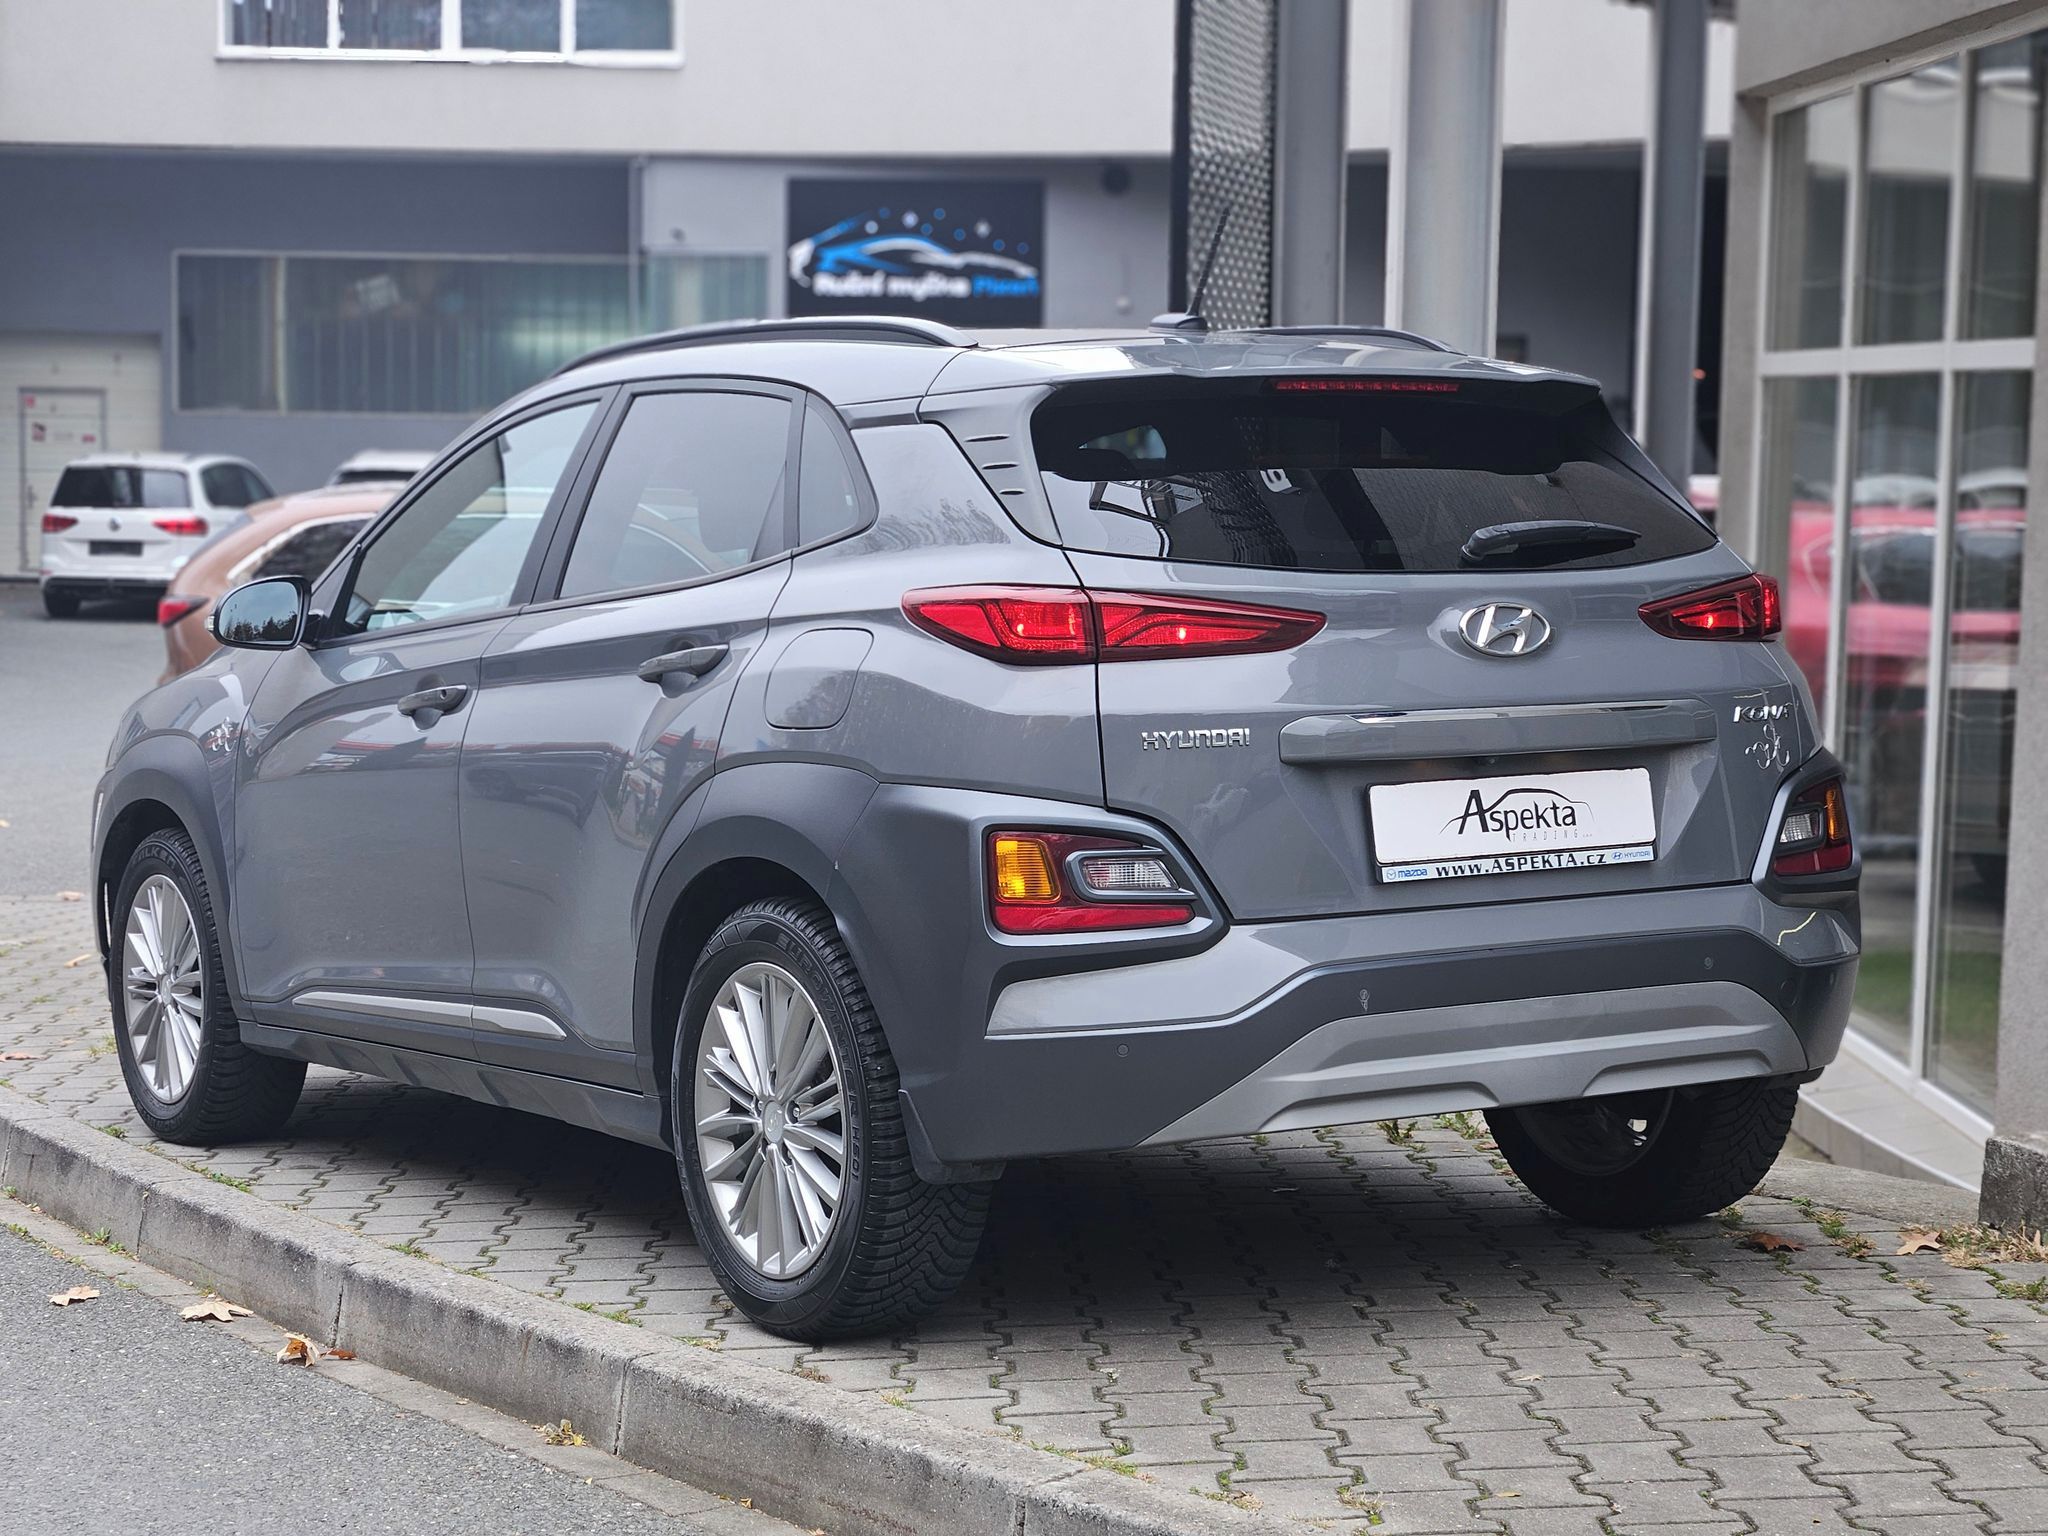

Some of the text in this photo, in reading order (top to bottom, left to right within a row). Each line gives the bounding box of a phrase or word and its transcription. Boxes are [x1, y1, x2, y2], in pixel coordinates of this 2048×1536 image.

[1141, 728, 1250, 751] HYUNDAI
[1457, 789, 1577, 842] Aspekta
[1511, 828, 1579, 842] TRADING
[1624, 850, 1651, 859] HYUNDAI
[1397, 868, 1428, 879] mazda
